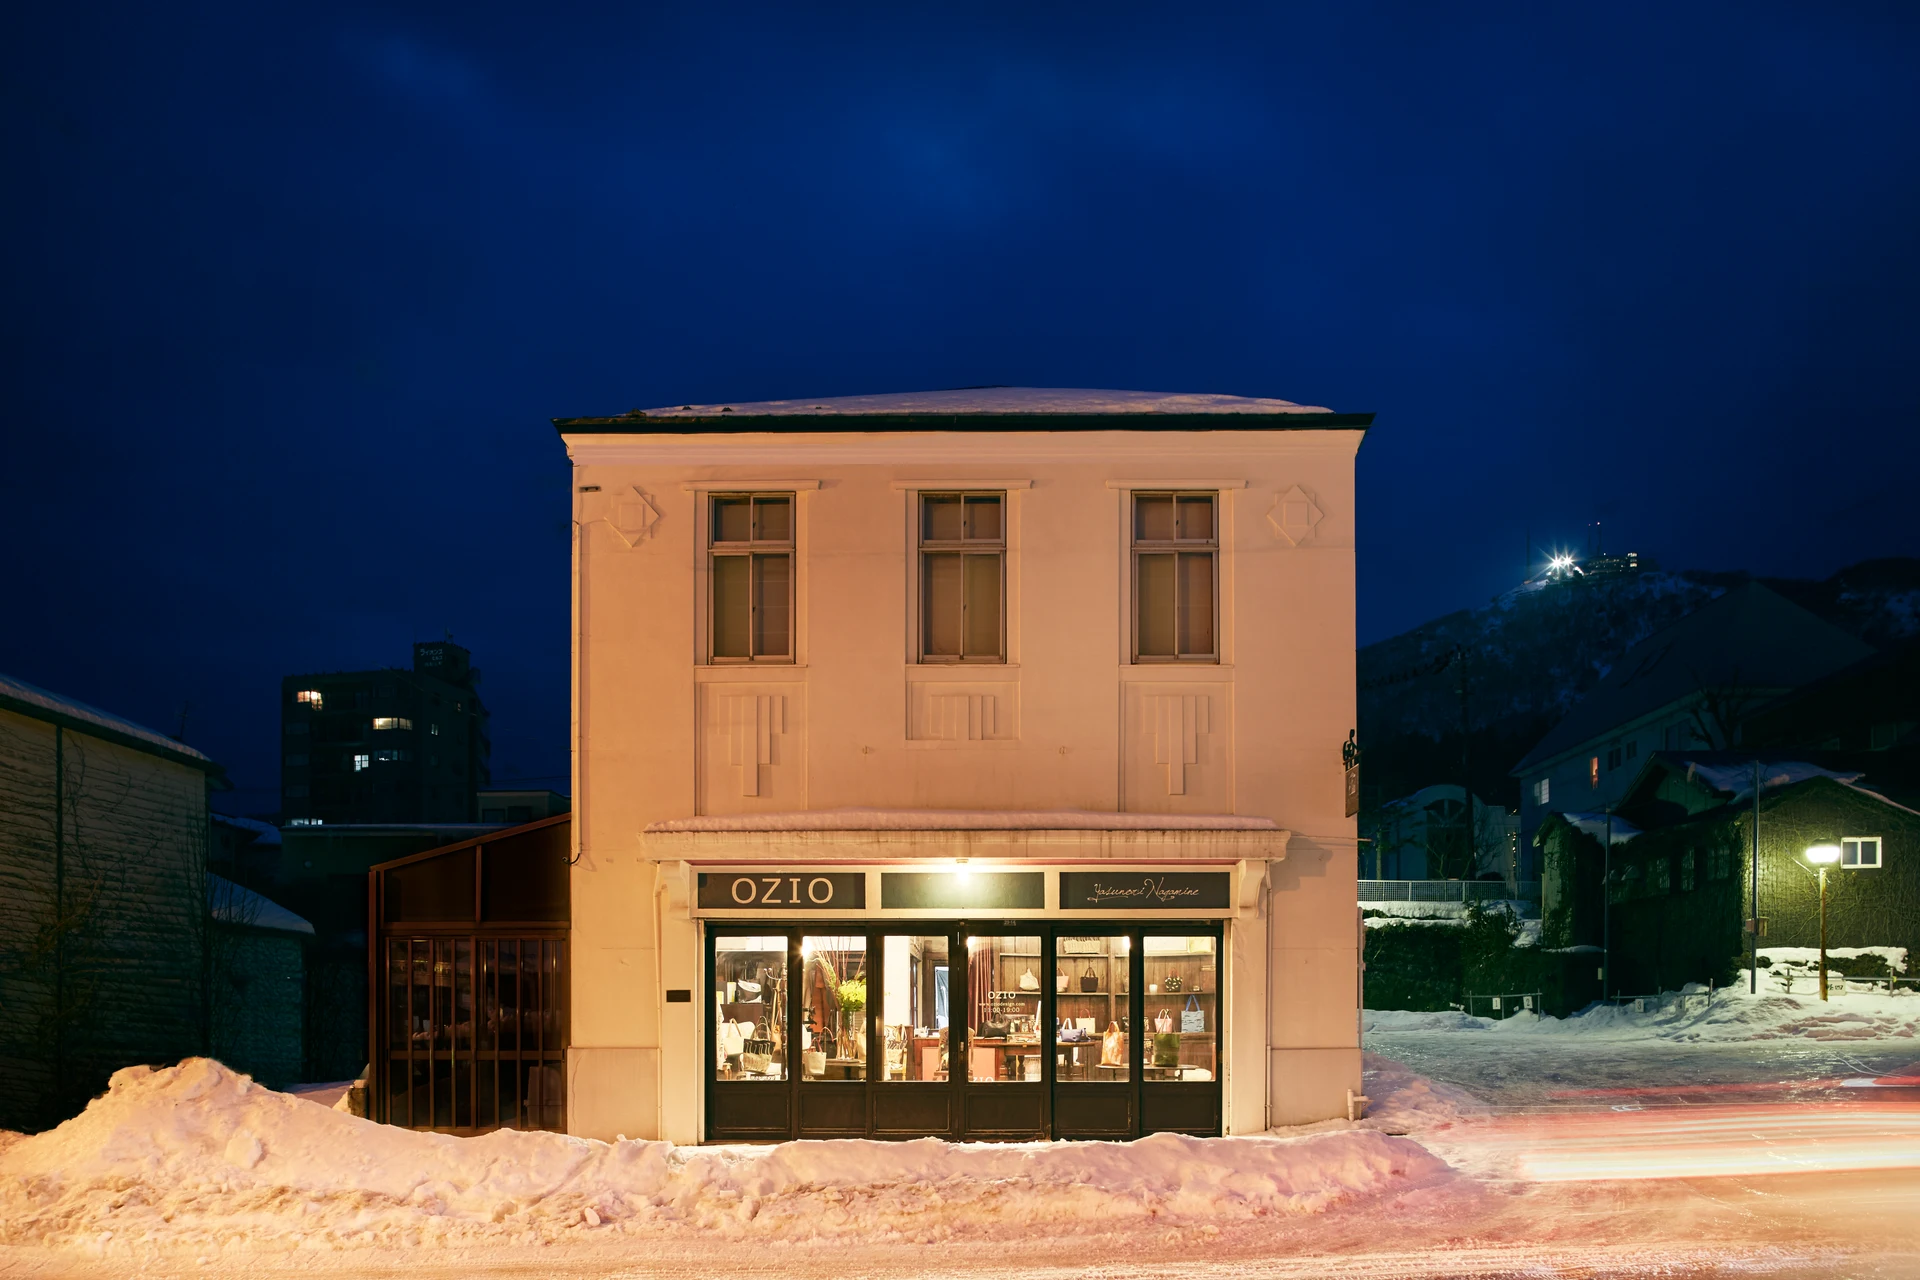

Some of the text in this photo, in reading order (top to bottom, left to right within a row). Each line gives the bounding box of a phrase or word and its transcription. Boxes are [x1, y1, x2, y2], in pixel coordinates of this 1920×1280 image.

[731, 877, 834, 904] OZIO
[1087, 877, 1199, 903] Yasunori Nagamine
[987, 991, 1016, 1000] OZIO
[1525, 998, 1531, 1007] 2
[1637, 1000, 1642, 1010] 3
